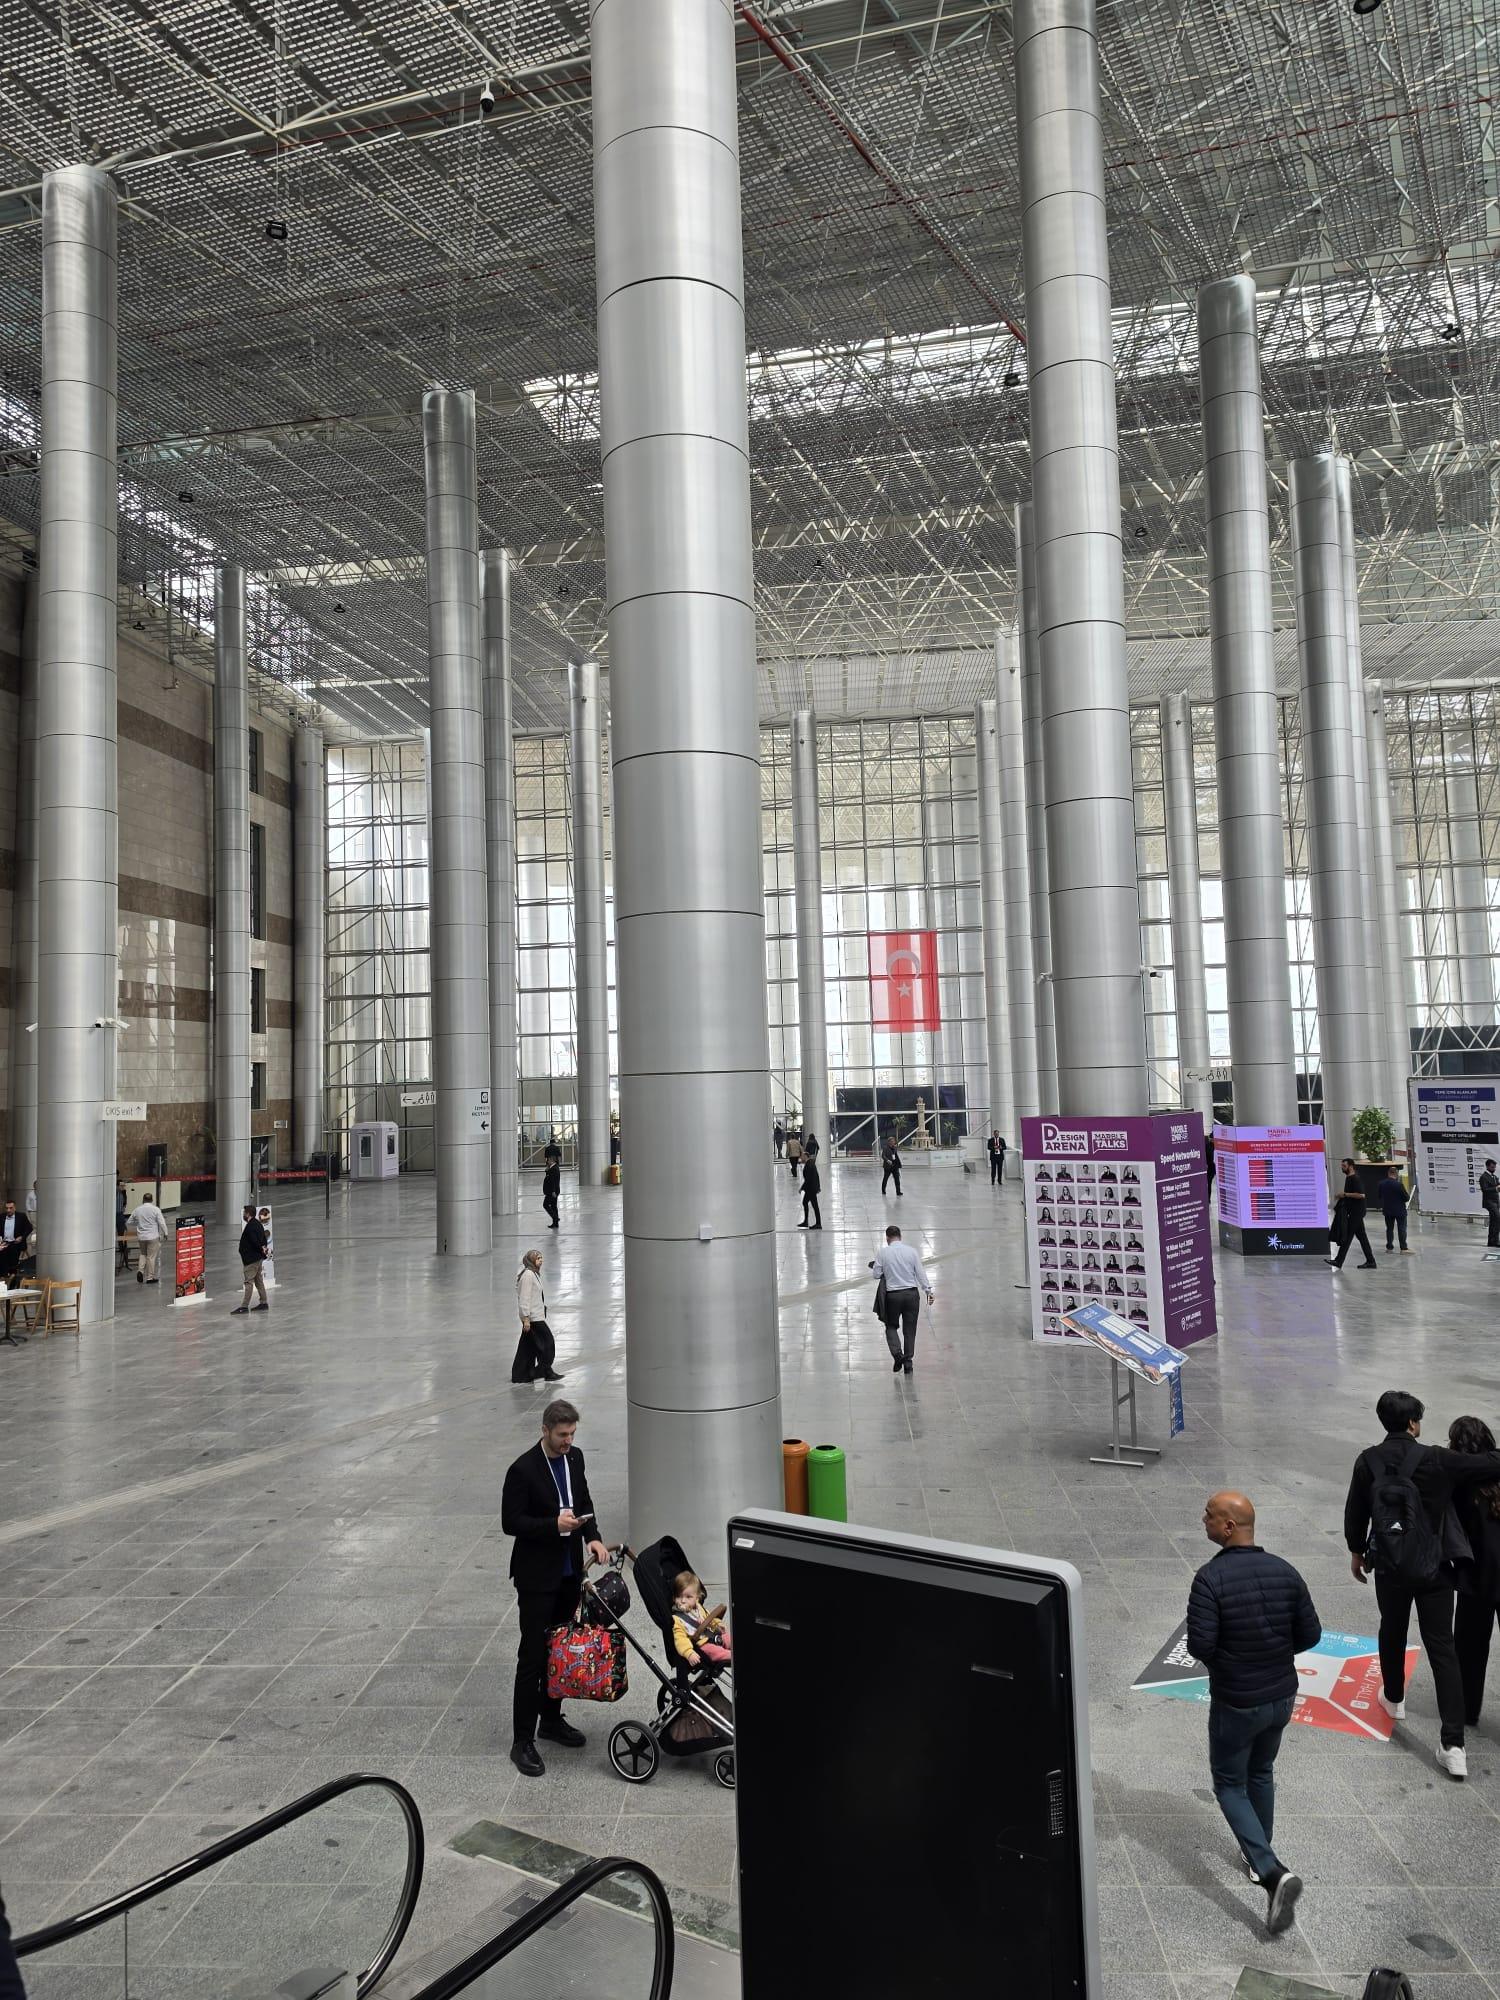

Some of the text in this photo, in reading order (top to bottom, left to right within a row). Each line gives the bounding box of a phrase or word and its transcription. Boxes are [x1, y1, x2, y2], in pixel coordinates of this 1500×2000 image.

[1170, 1124, 1188, 1135] MARBLE
[1045, 1142, 1087, 1152] ARENA
[1095, 1139, 1126, 1149] TALKS
[1160, 1149, 1201, 1166] Speed Networking
[1171, 1163, 1191, 1174] Program
